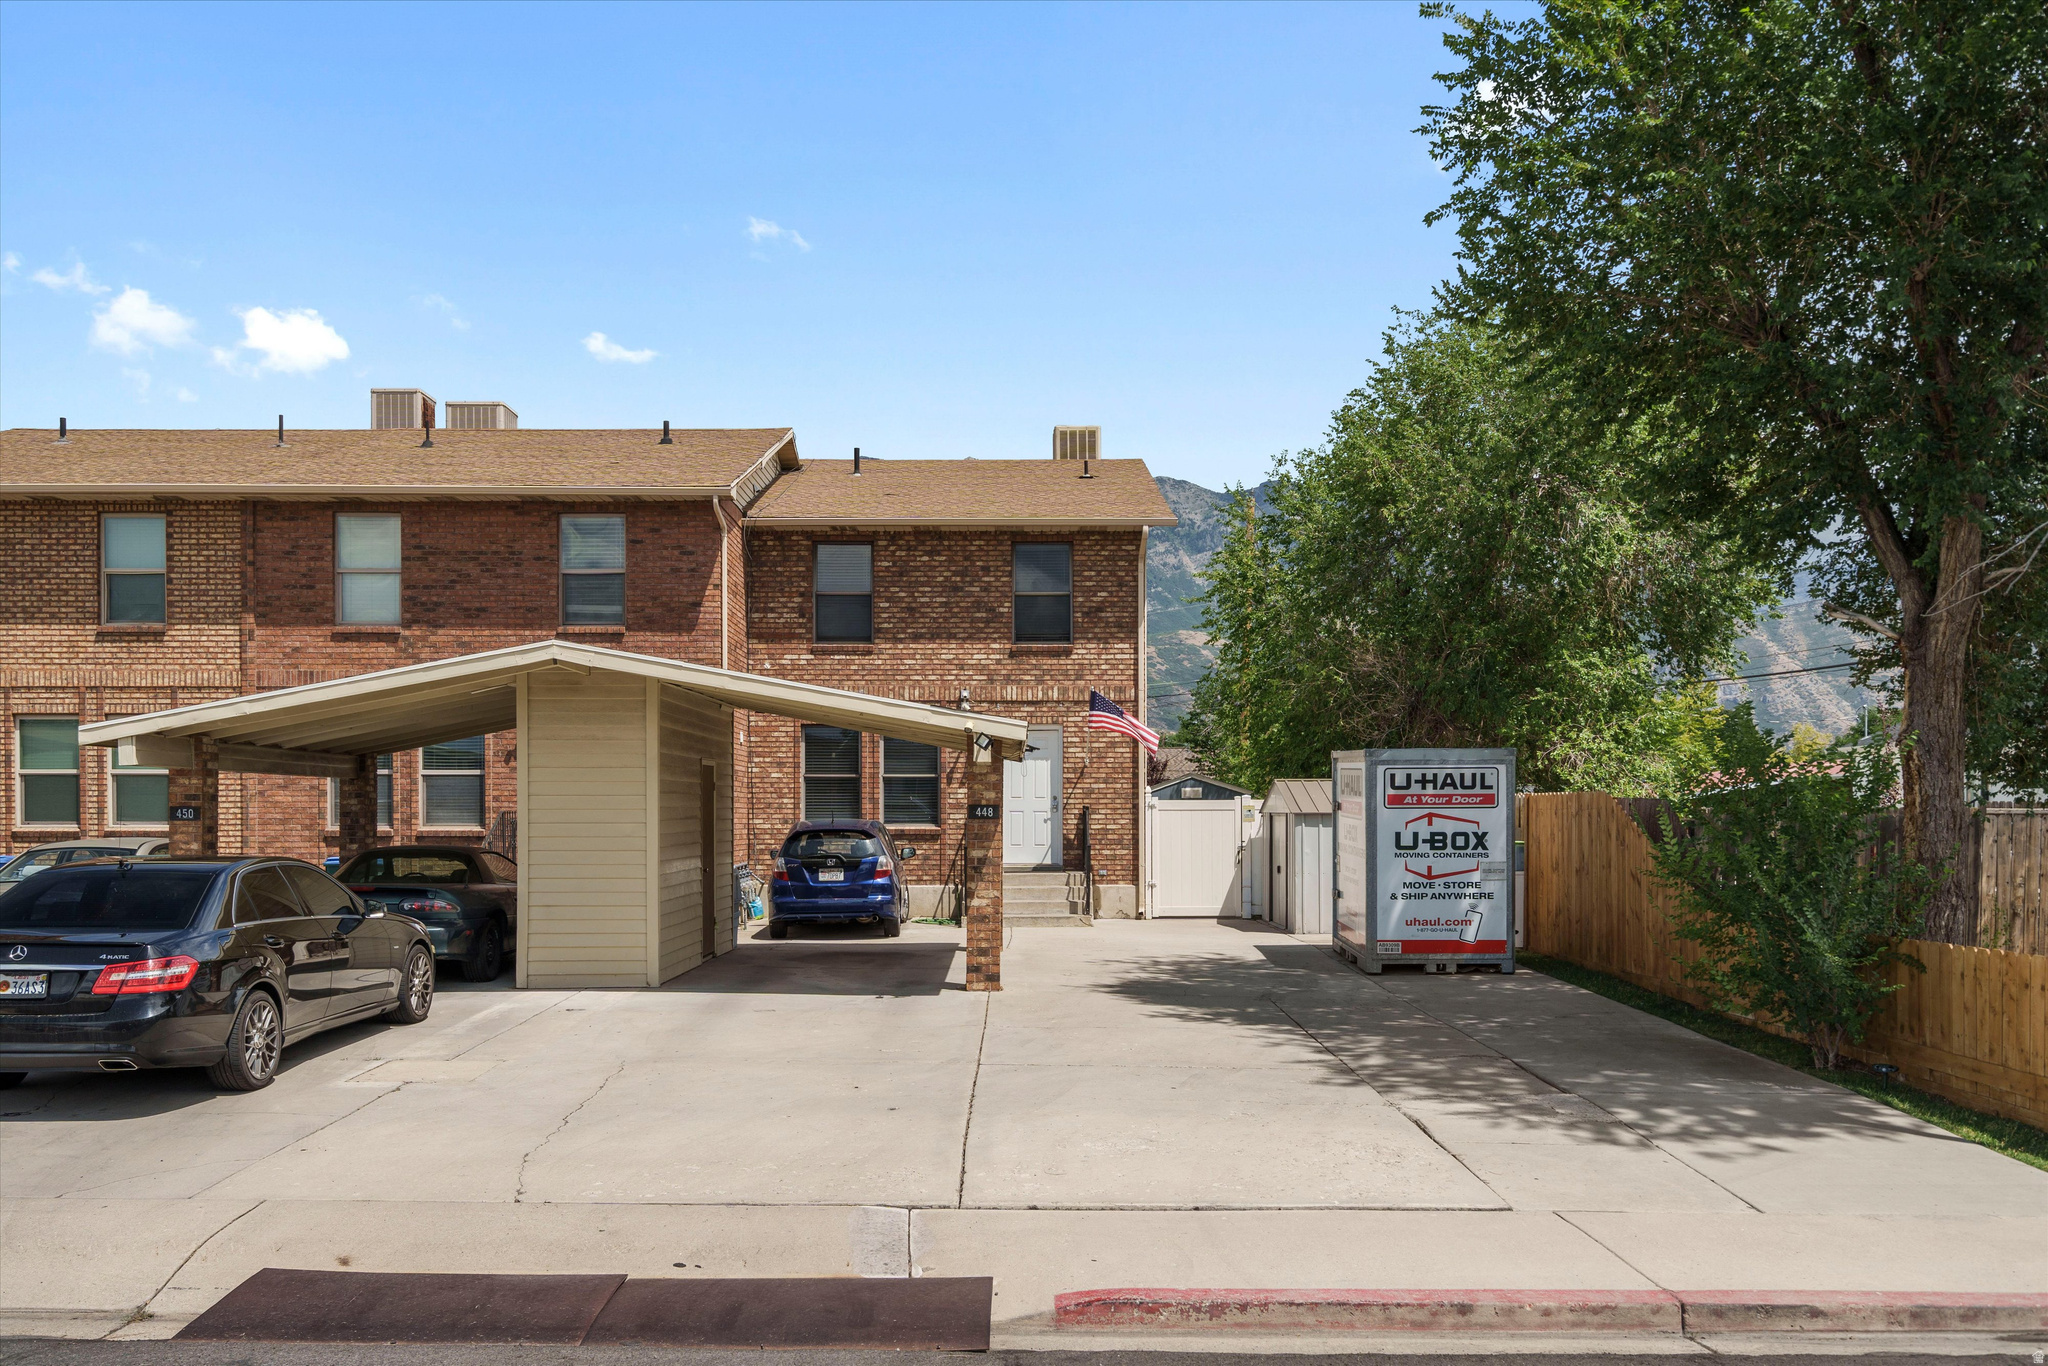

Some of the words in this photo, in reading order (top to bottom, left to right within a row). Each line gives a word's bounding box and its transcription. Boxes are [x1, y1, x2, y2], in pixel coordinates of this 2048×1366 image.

[1389, 772, 1494, 791] U-HAUL
[1403, 795, 1418, 804] At
[1421, 795, 1449, 804] Your
[1451, 795, 1483, 804] Door
[176, 808, 194, 819] 450
[975, 807, 994, 818] 448
[1394, 831, 1490, 851] U-BOX
[1402, 881, 1436, 890] MOVE
[1443, 881, 1482, 890] STORE
[1389, 892, 1399, 901] &
[1401, 892, 1428, 900] SHIP
[1430, 892, 1495, 900] ANYWHERE
[1405, 917, 1472, 927] uhaul.com
